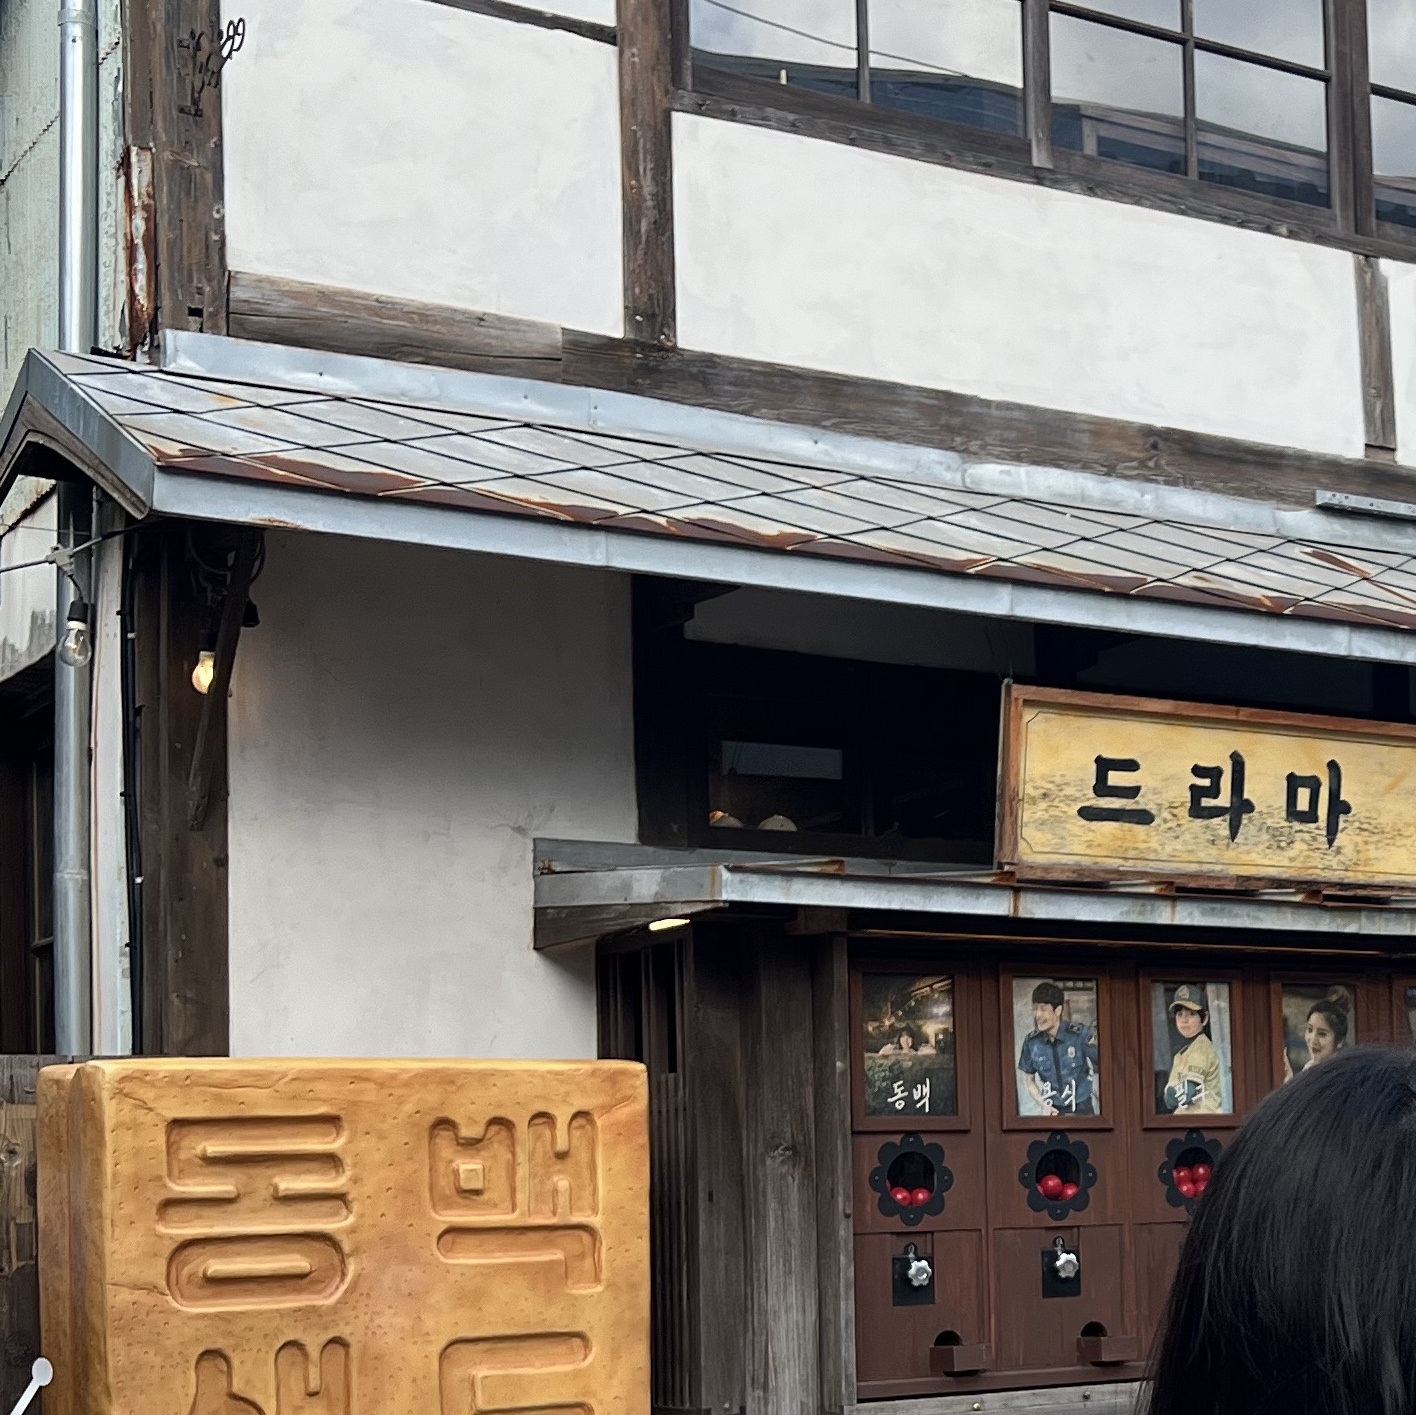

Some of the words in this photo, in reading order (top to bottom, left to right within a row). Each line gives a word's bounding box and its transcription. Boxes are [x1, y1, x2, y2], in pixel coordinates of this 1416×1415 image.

[1076, 749, 1353, 850] 드라마
[887, 1078, 930, 1112] 동백
[1041, 1079, 1076, 1112] 용식
